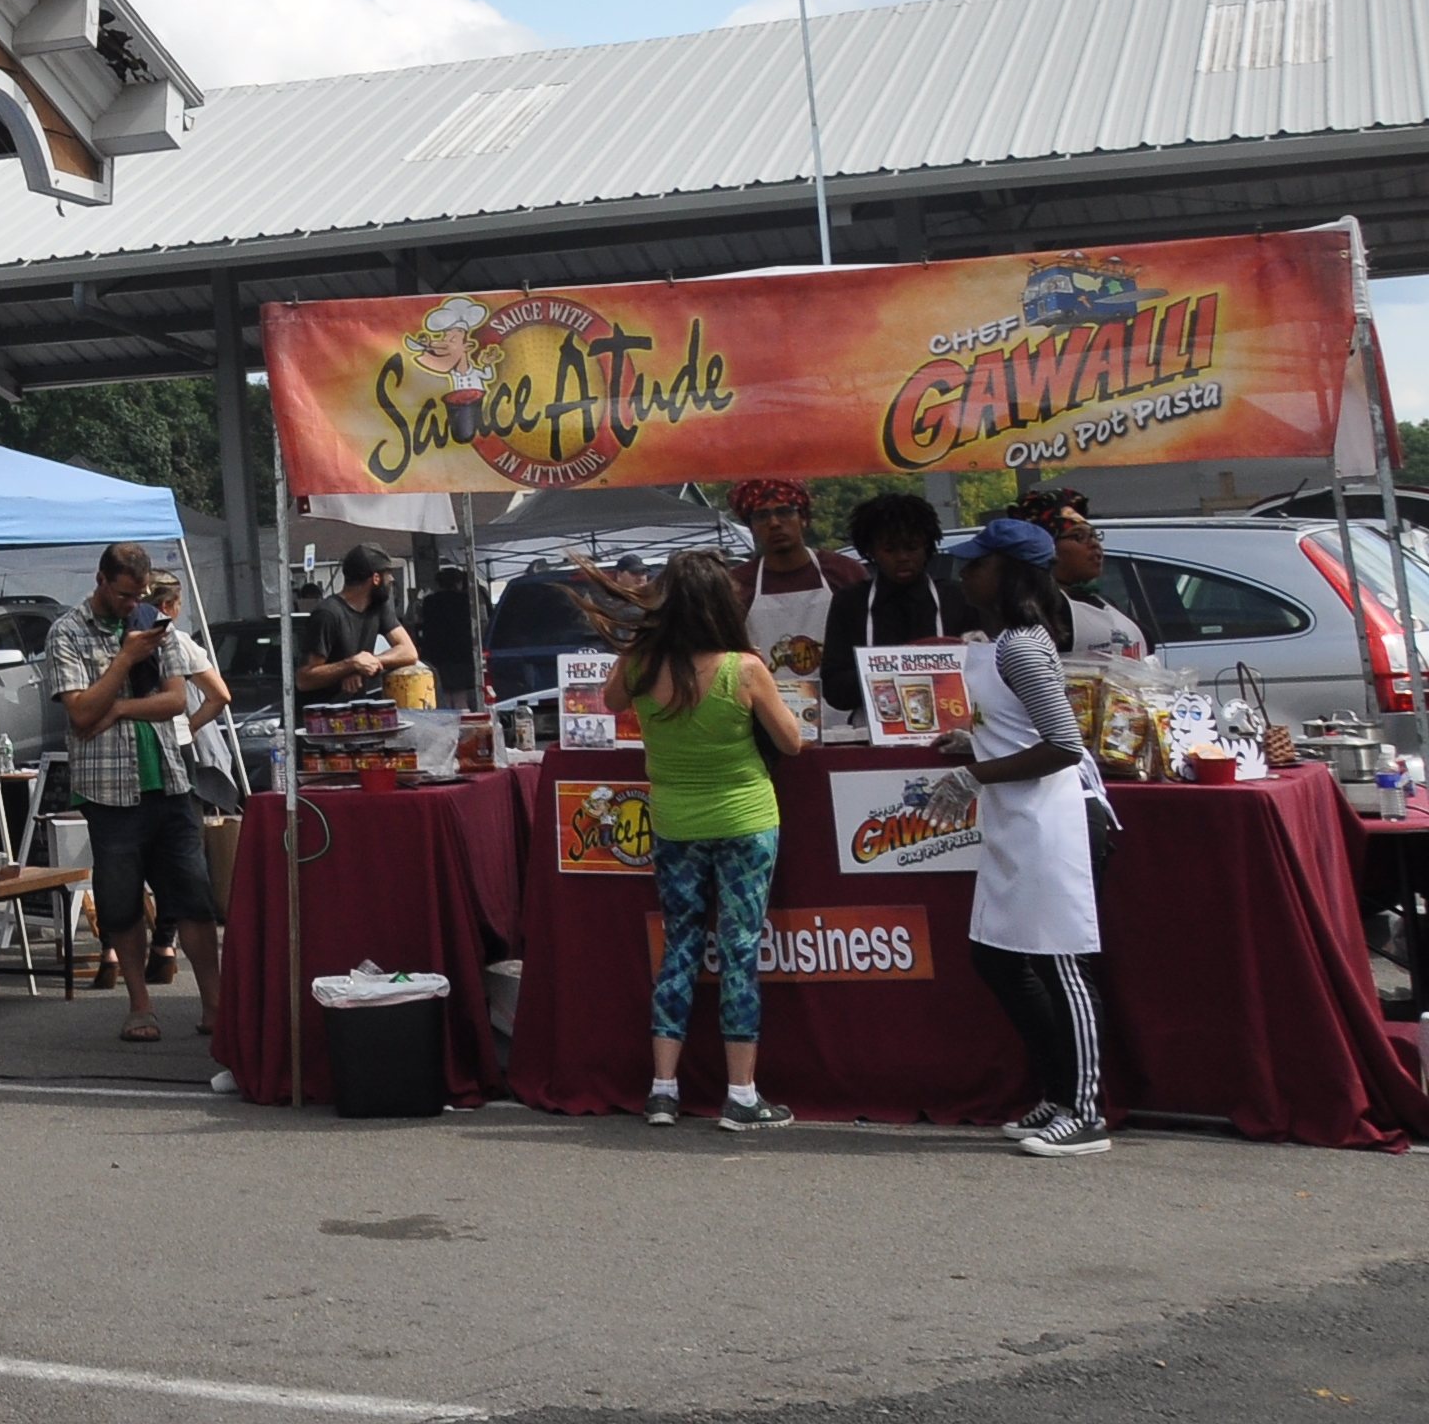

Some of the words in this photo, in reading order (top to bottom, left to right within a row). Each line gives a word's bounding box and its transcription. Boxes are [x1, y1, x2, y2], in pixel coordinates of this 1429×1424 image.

[490, 302, 542, 334] SAUCE
[549, 302, 593, 332] WITH
[928, 314, 1022, 356] CHEF
[883, 291, 1219, 470] GAWALLI
[1004, 434, 1067, 469] One
[1075, 410, 1126, 450] Pot
[1133, 382, 1221, 426] Pasta
[494, 450, 518, 471] AN
[520, 448, 606, 485] ATTITUDE
[868, 654, 899, 664] HELP
[900, 652, 954, 664] SUPPORT
[939, 697, 965, 718] $6
